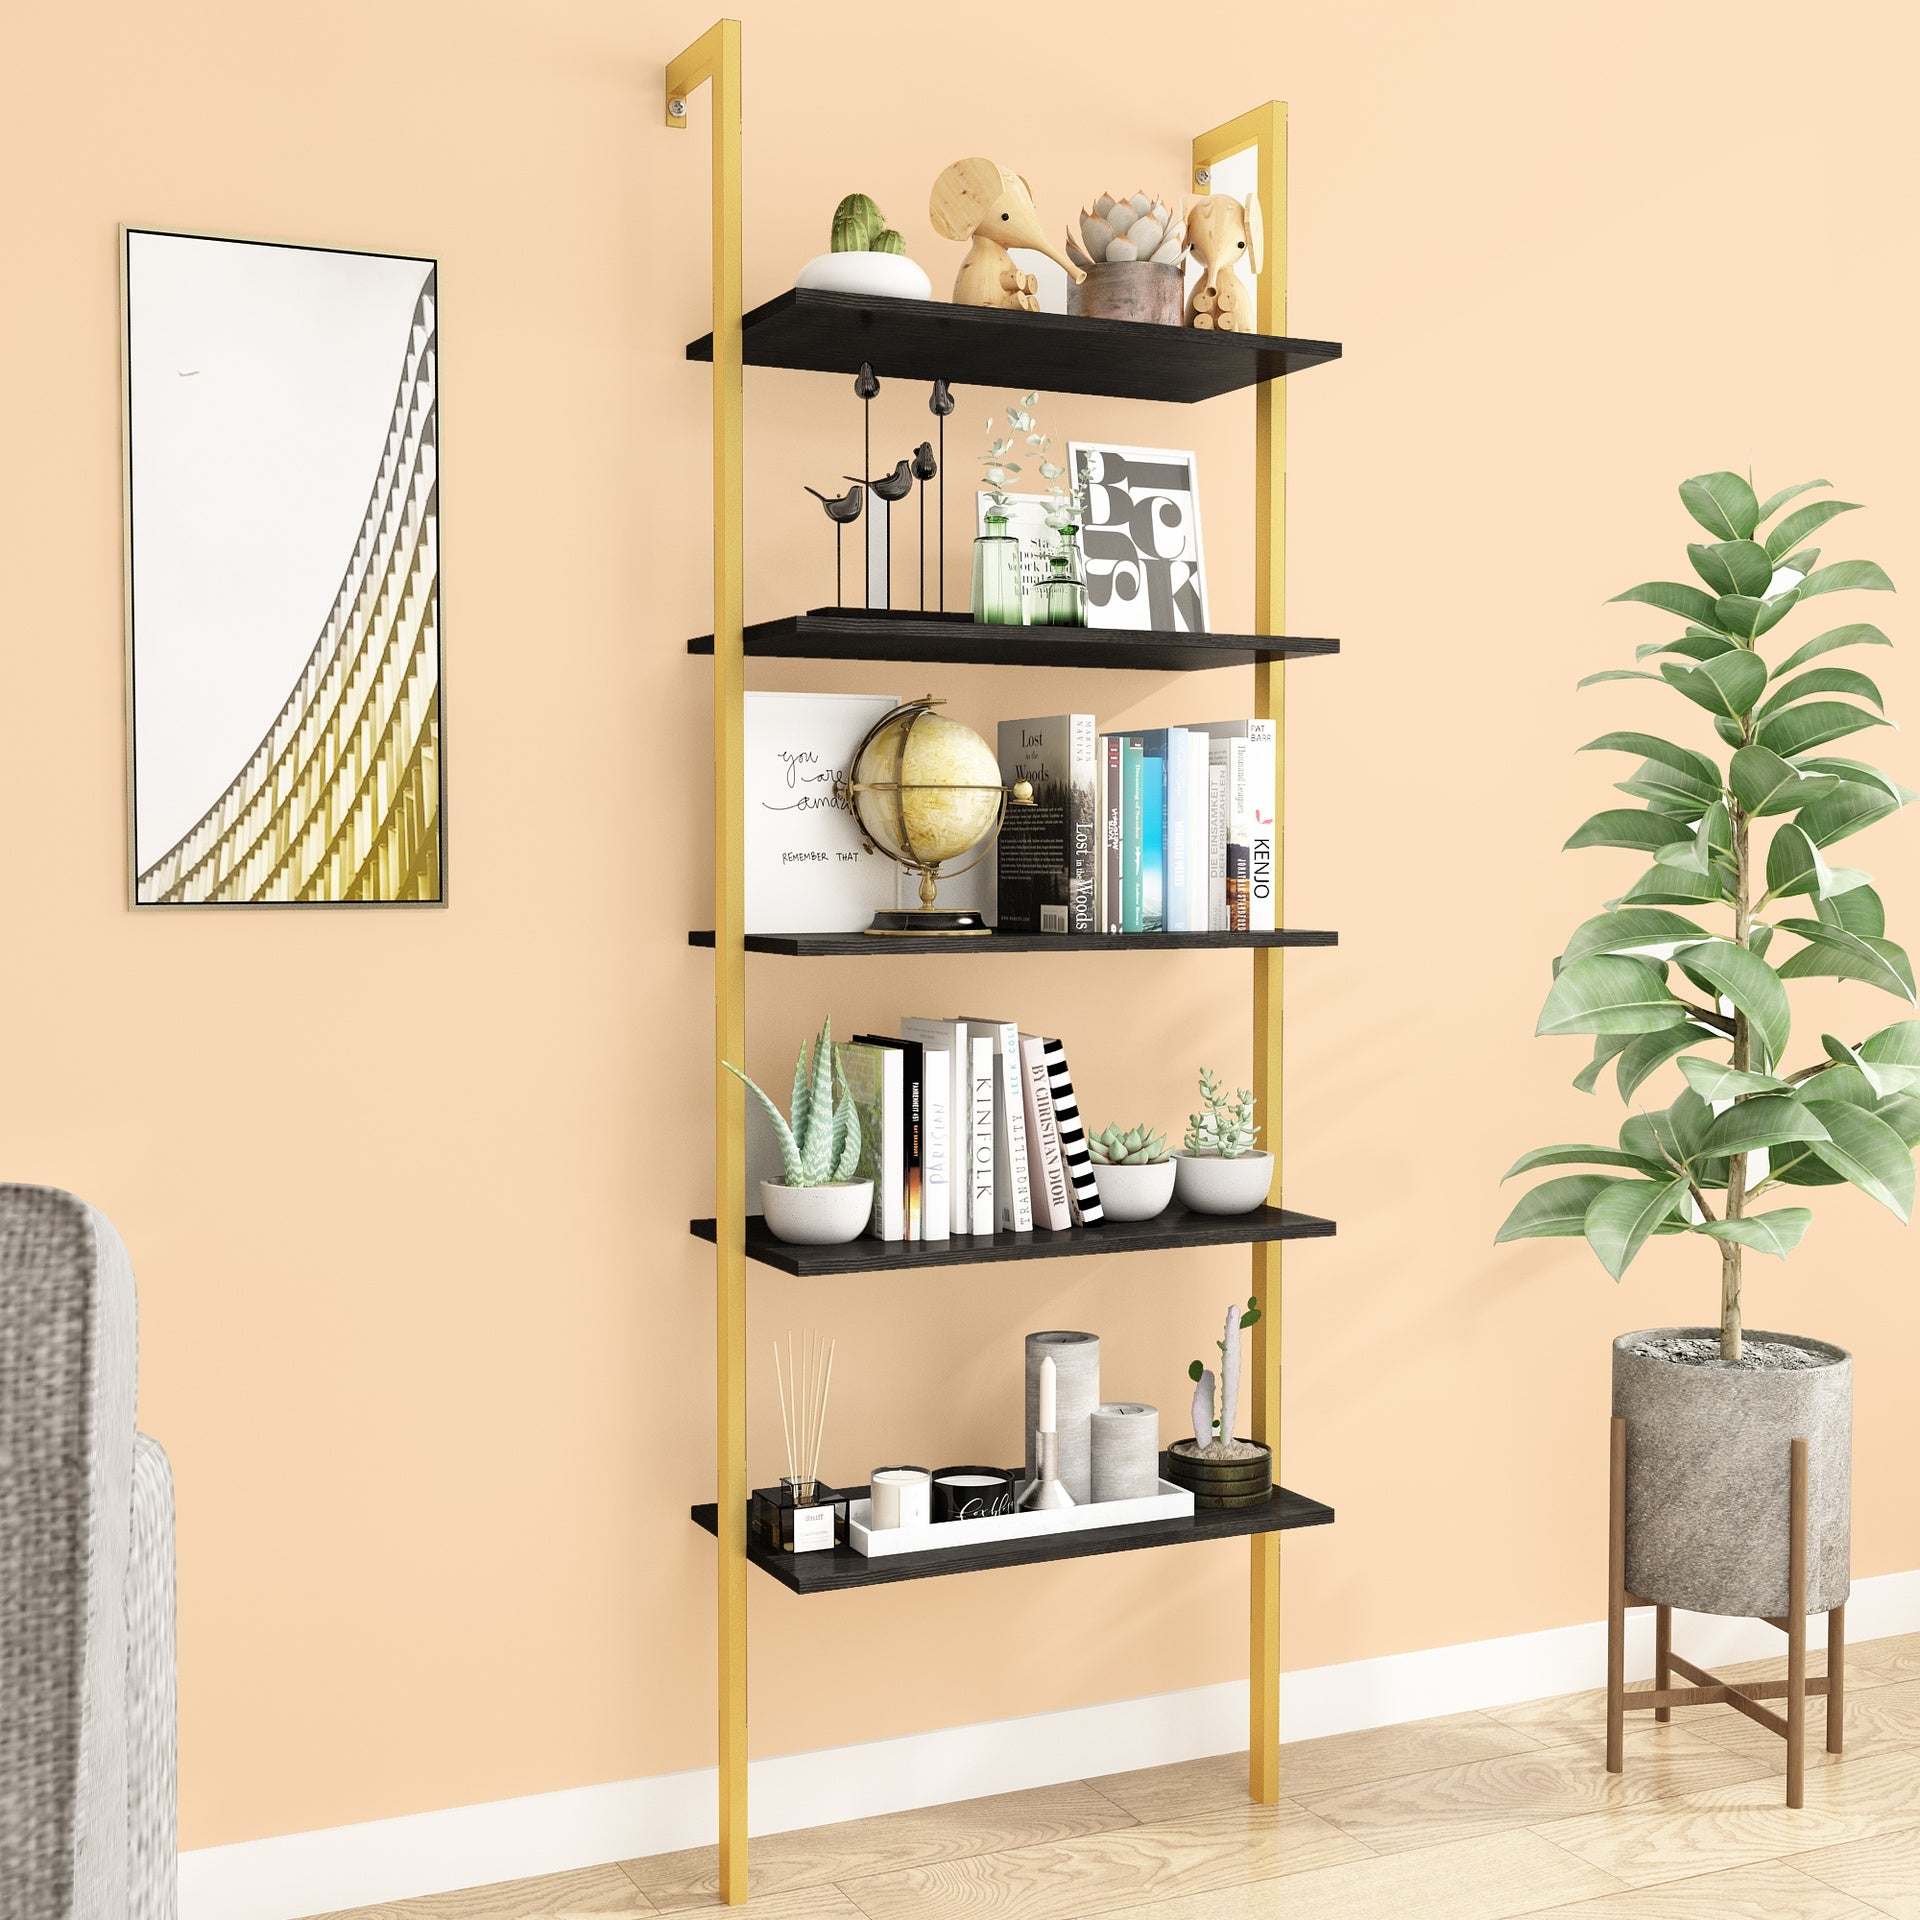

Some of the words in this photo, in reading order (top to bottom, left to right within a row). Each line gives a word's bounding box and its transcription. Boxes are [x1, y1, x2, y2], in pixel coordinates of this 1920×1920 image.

[1022, 730, 1043, 748] Lost
[1251, 724, 1265, 732] PAT
[1251, 733, 1272, 742] BARR
[778, 751, 818, 788] you
[1031, 751, 1039, 760] the
[1237, 745, 1246, 782] Thousand
[801, 769, 847, 785] are
[1015, 763, 1049, 782] Woods
[1075, 822, 1093, 856] Lost
[782, 851, 829, 865] REMEMBER
[1076, 859, 1084, 867] in
[1253, 839, 1270, 899] KENJO
[1075, 868, 1085, 879] the
[1075, 879, 1094, 930] Woods
[1006, 1025, 1016, 1053] COLE
[1032, 1064, 1047, 1085] BY
[976, 1078, 992, 1199] KINFOLK
[1036, 1087, 1060, 1166] CHRISTIAN
[926, 1103, 949, 1184] PARISIAN
[1012, 1115, 1030, 1226] TRANQUILITY
[1048, 1169, 1065, 1208] DIOR
